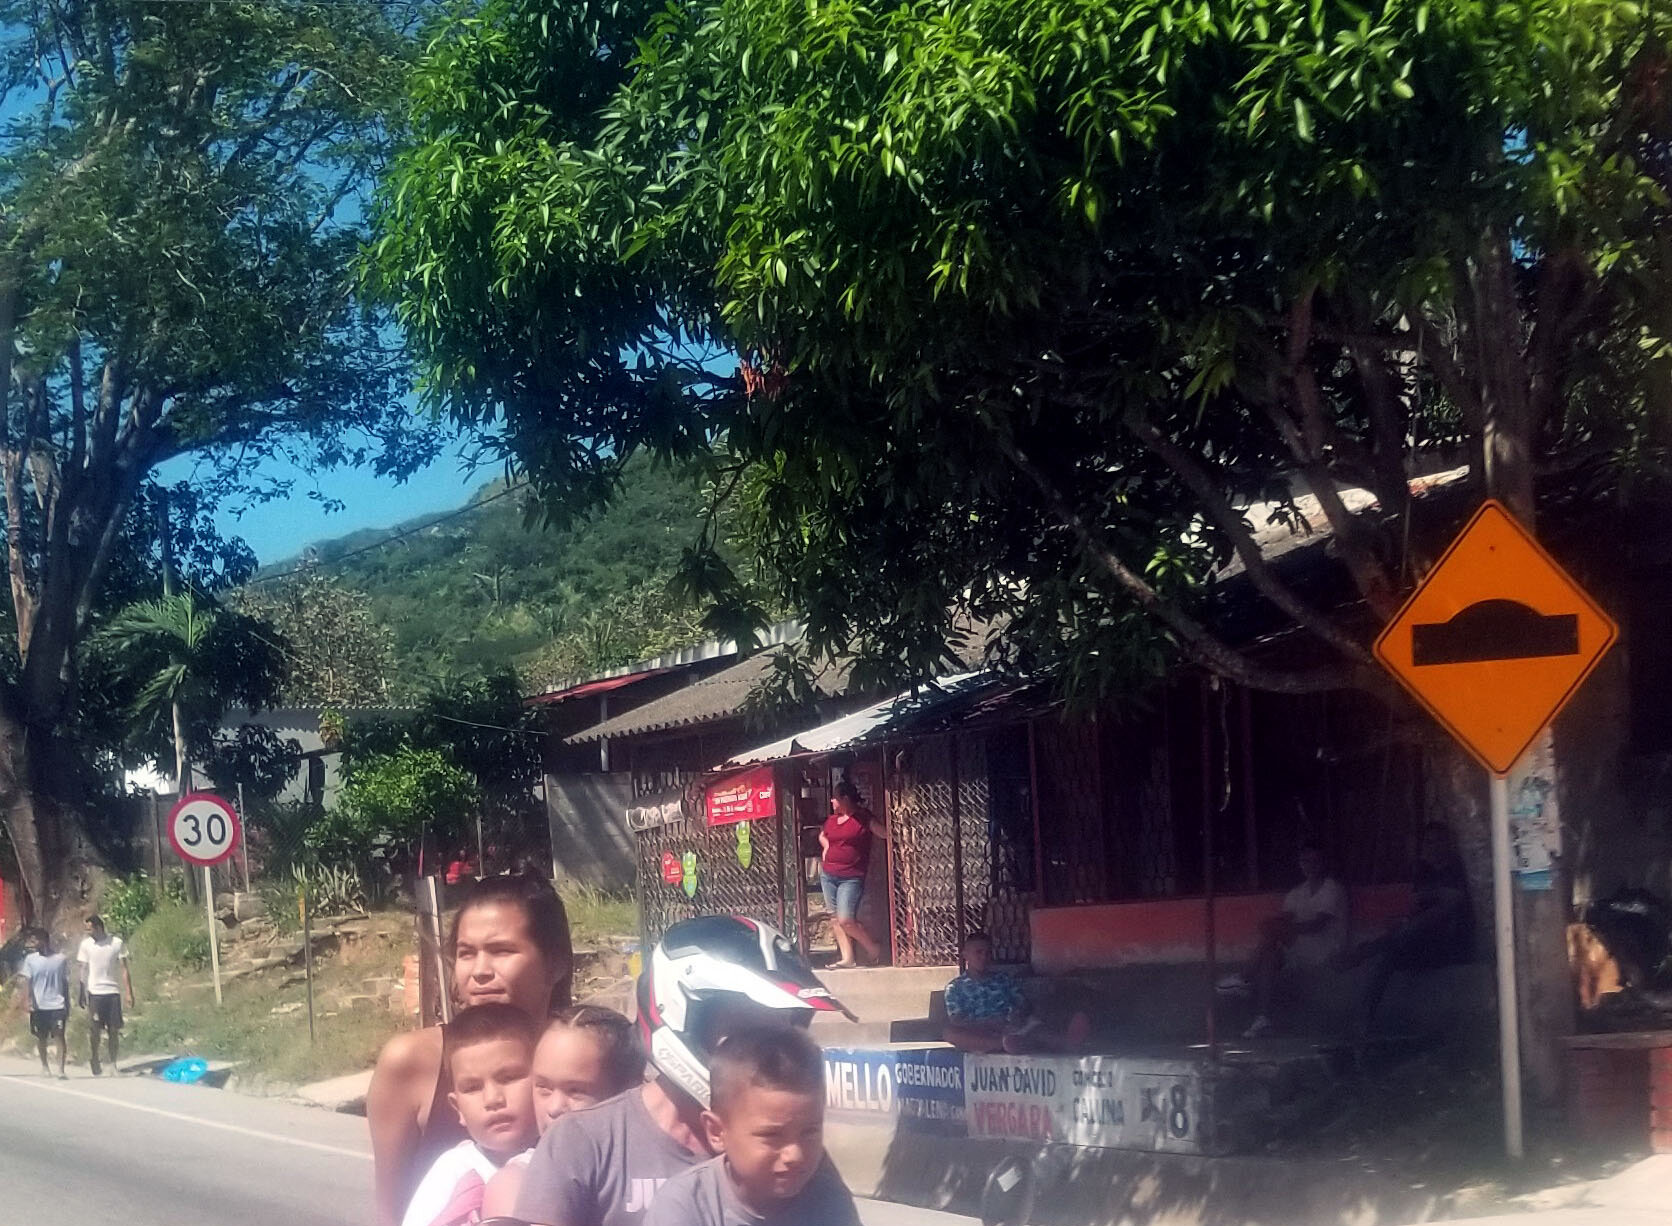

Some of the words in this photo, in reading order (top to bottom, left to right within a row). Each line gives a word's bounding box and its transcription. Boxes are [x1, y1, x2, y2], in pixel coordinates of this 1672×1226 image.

[183, 813, 227, 847] 30
[825, 1060, 892, 1112] MELLO
[895, 1062, 962, 1089] GOBERNADOR
[971, 1066, 1010, 1093] JUAN
[1014, 1066, 1056, 1097] DAVID
[973, 1102, 1054, 1139] VERGARA
